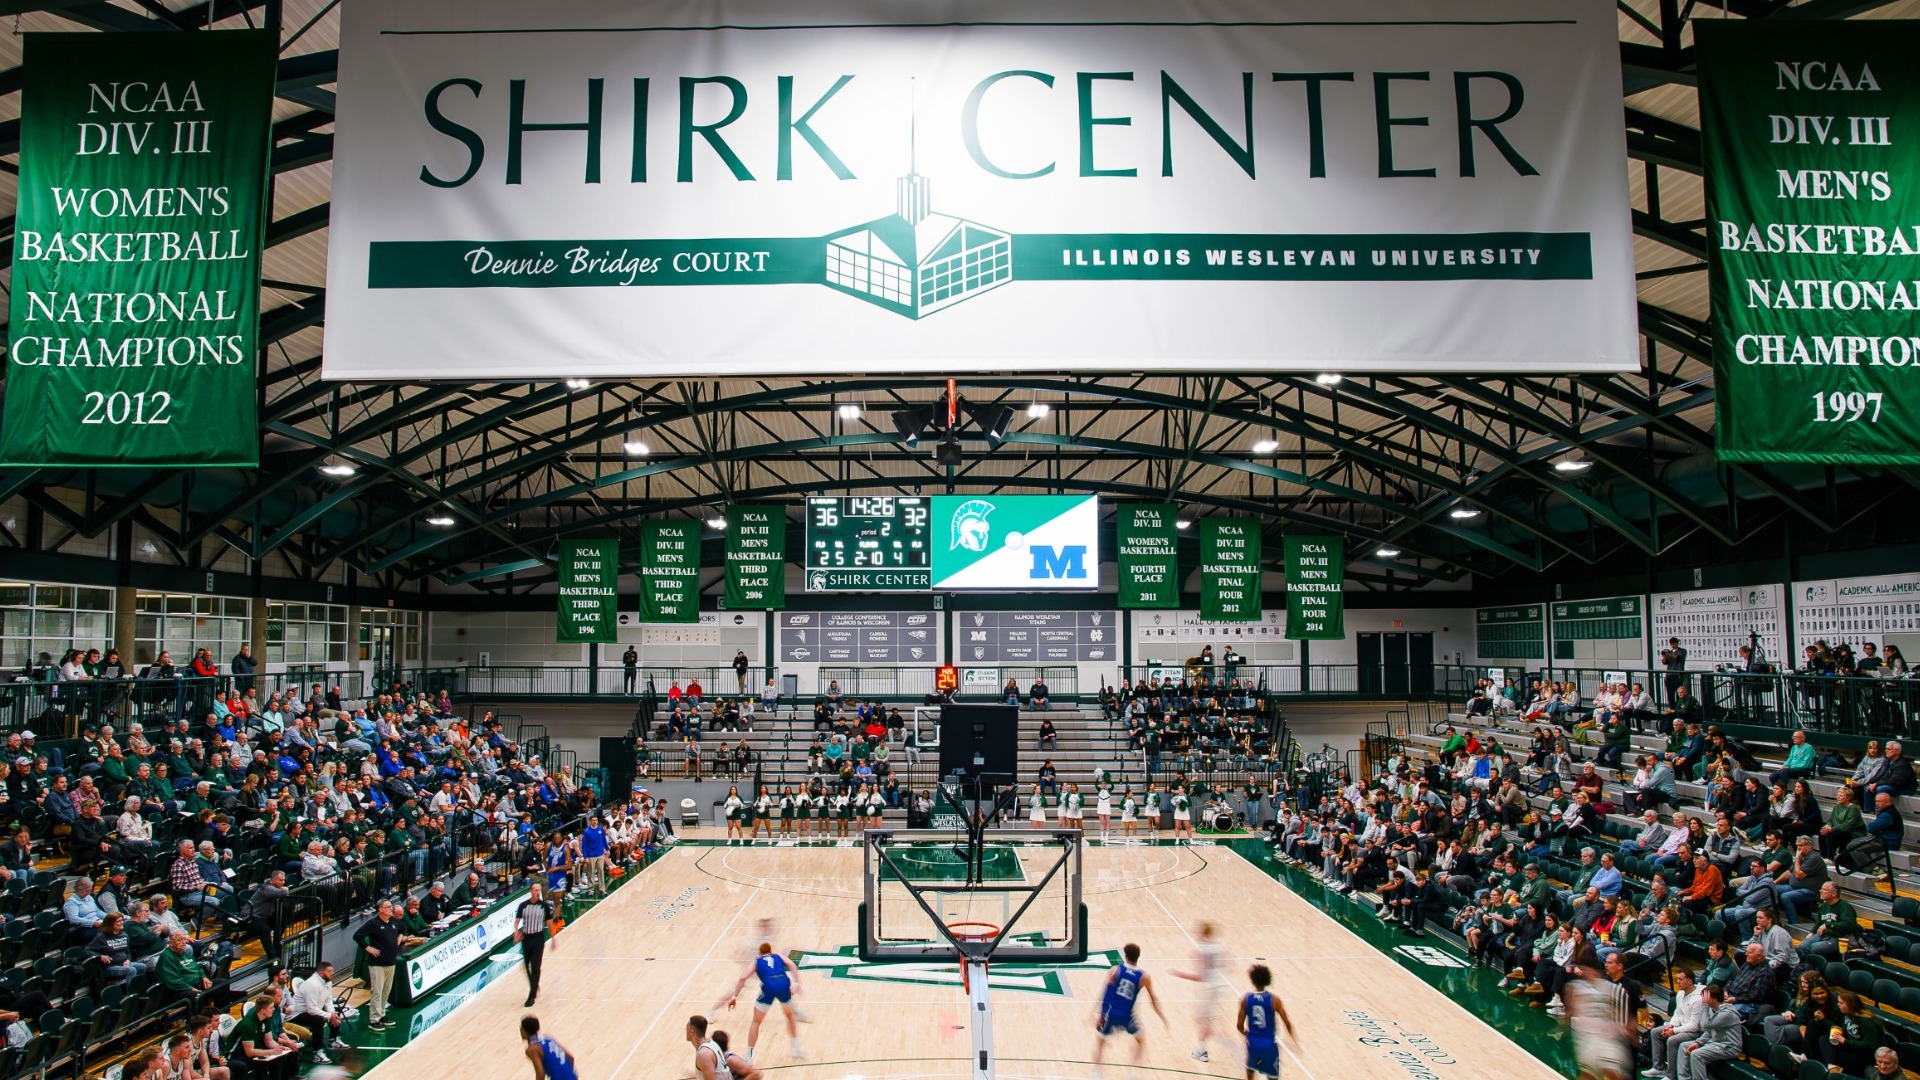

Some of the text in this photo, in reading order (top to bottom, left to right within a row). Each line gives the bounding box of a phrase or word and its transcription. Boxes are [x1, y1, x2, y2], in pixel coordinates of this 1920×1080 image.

[1775, 62, 1881, 90] NCAA
[88, 81, 204, 113] NCAA
[420, 69, 1541, 189] SHIRK CENTER
[1769, 115, 1891, 145] DIV. III
[76, 121, 212, 155] DIV. III
[1777, 170, 1891, 201] MEN'S
[51, 187, 228, 217] WOMEN'S
[20, 230, 248, 262] BASKETBALL
[1063, 249, 1540, 265] ILLINOIS WESLEYAN UNIVERSITY
[464, 247, 769, 285] Dennie Bridges COURT
[26, 291, 235, 322] NATIONAL
[12, 335, 242, 367] CHAMPIONS
[82, 391, 171, 424] 2012
[1813, 392, 1882, 422] 1997
[852, 498, 893, 515] 14:26
[816, 508, 838, 526] 36
[905, 508, 926, 526] 32
[1136, 510, 1160, 518] NCAA
[659, 529, 683, 537] NCAA
[881, 523, 890, 536] 2
[657, 541, 684, 549] DIV. III
[742, 539, 768, 547] MEN'S
[1128, 538, 1168, 546] WOMEN'S
[1217, 539, 1244, 547] DIV. III
[576, 549, 600, 557] NCAA
[1121, 546, 1176, 555] BASKETBALL
[1302, 545, 1326, 553] NCAA
[657, 554, 683, 562] MEN'S
[727, 552, 782, 560] BASKETBALL
[820, 552, 829, 565] 2
[836, 552, 844, 564] 5
[894, 552, 902, 564] 4
[922, 552, 925, 564] 1
[1218, 552, 1243, 560] MEN'S
[574, 562, 589, 570] DIV.
[1030, 546, 1086, 578] M
[1300, 558, 1328, 566] DIV. III
[642, 567, 697, 575] BASKETBALL
[740, 565, 767, 573] THIRD
[1131, 565, 1166, 573] FOURTH
[1203, 565, 1258, 573] BASKETBALL
[575, 574, 600, 582] MEN'S
[1135, 574, 1163, 583] PLACE
[1301, 571, 1327, 579] MEN'S
[1695, 571, 1701, 583] K
[655, 580, 682, 588] THIRD
[740, 578, 768, 586] PLACE
[830, 575, 928, 585] SHIRK CENTER
[1218, 578, 1244, 586] FINAL
[560, 587, 615, 596] BASKETBALL
[1287, 583, 1341, 592] BASKETBALL
[1840, 585, 1873, 595] ACADEMIC
[655, 593, 683, 601] PLACE
[746, 591, 762, 599] 2006
[1140, 593, 1156, 601] 2011
[1219, 591, 1243, 599] FOUR
[573, 600, 599, 608] THIRD
[935, 598, 941, 607] H
[1302, 597, 1327, 605] FINAL
[661, 606, 676, 614] 2001
[1222, 604, 1239, 612] 2012
[573, 613, 600, 621] PLACE
[1303, 610, 1326, 618] FOUR
[579, 626, 594, 634] 1996
[1306, 623, 1323, 631] 2014
[971, 631, 986, 640] M
[939, 675, 956, 688] 24
[424, 933, 476, 970] ILLINOIS WESLEYAN
[1400, 1032, 1456, 1064] COURT
